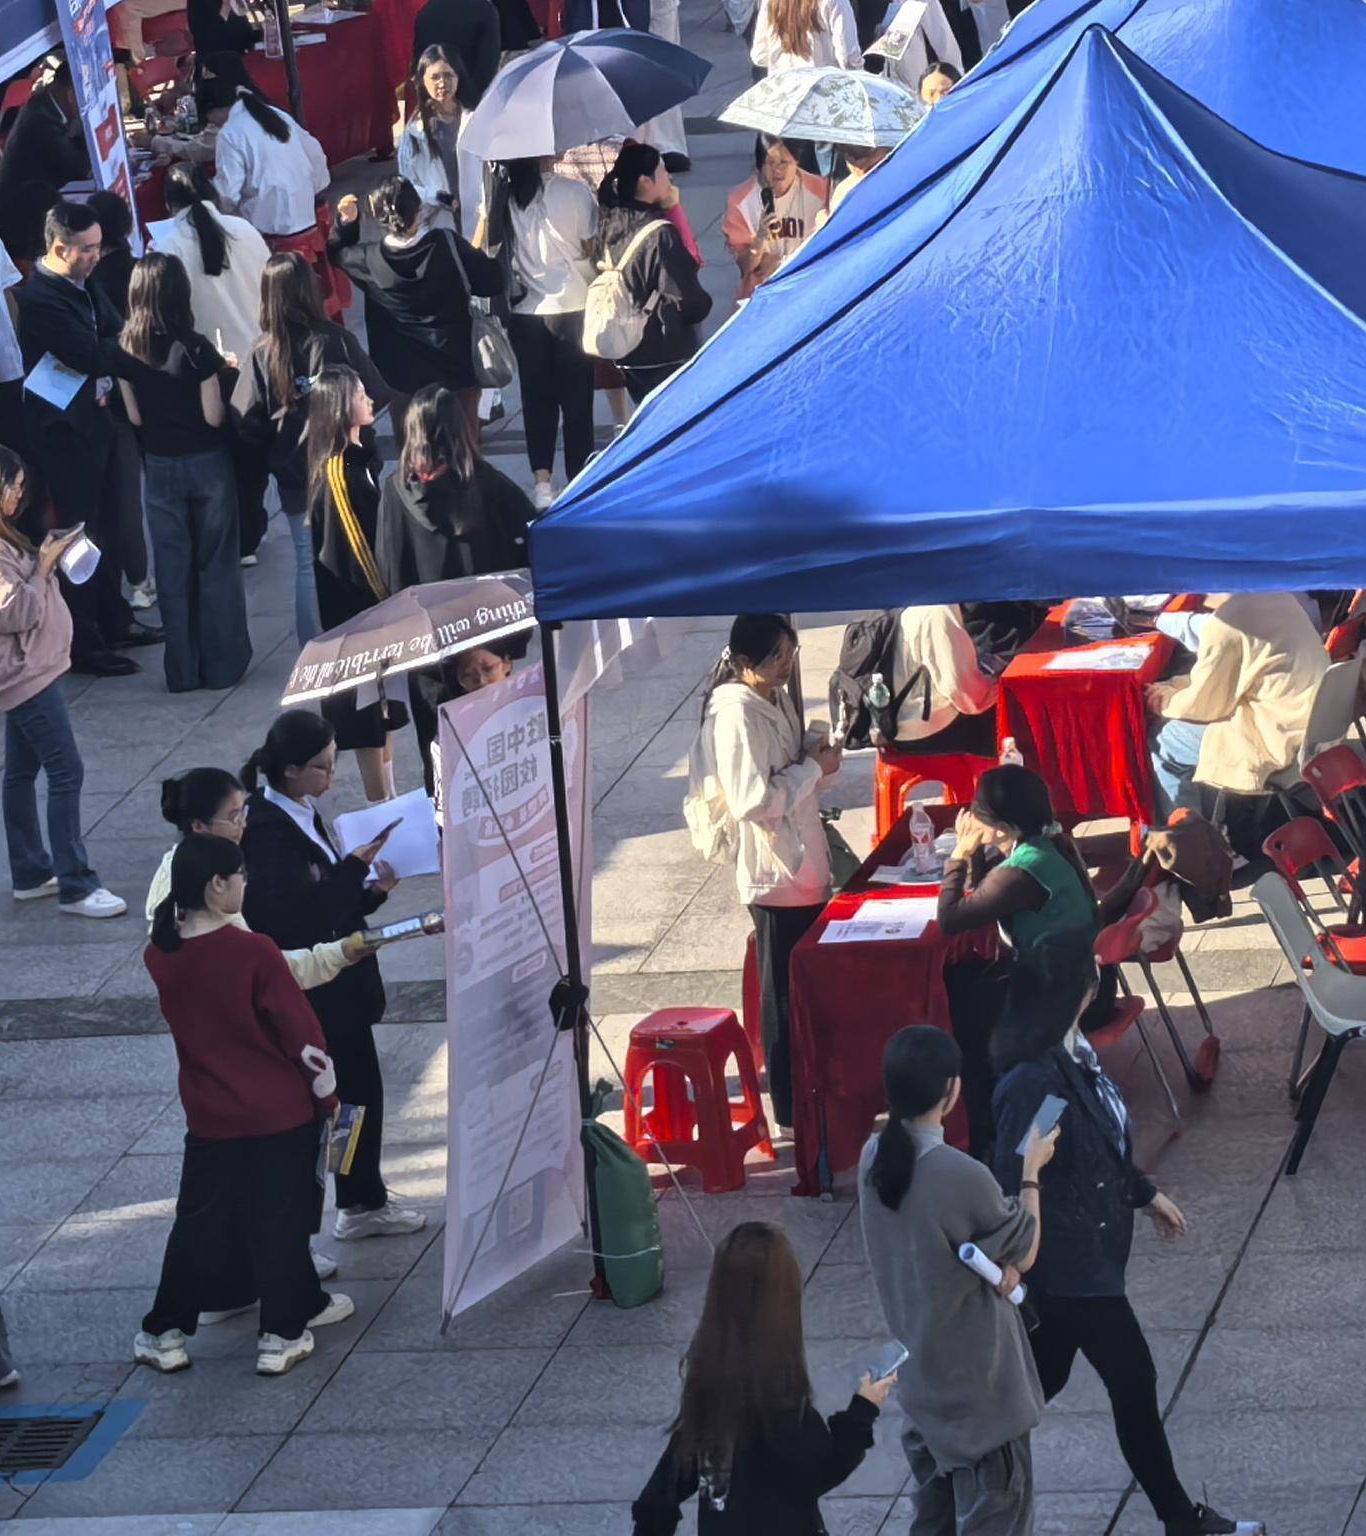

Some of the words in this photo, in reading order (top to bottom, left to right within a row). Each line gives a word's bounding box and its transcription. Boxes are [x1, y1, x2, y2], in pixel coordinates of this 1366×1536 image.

[409, 633, 433, 655] be
[438, 617, 471, 645] will
[336, 641, 404, 679] terrible
